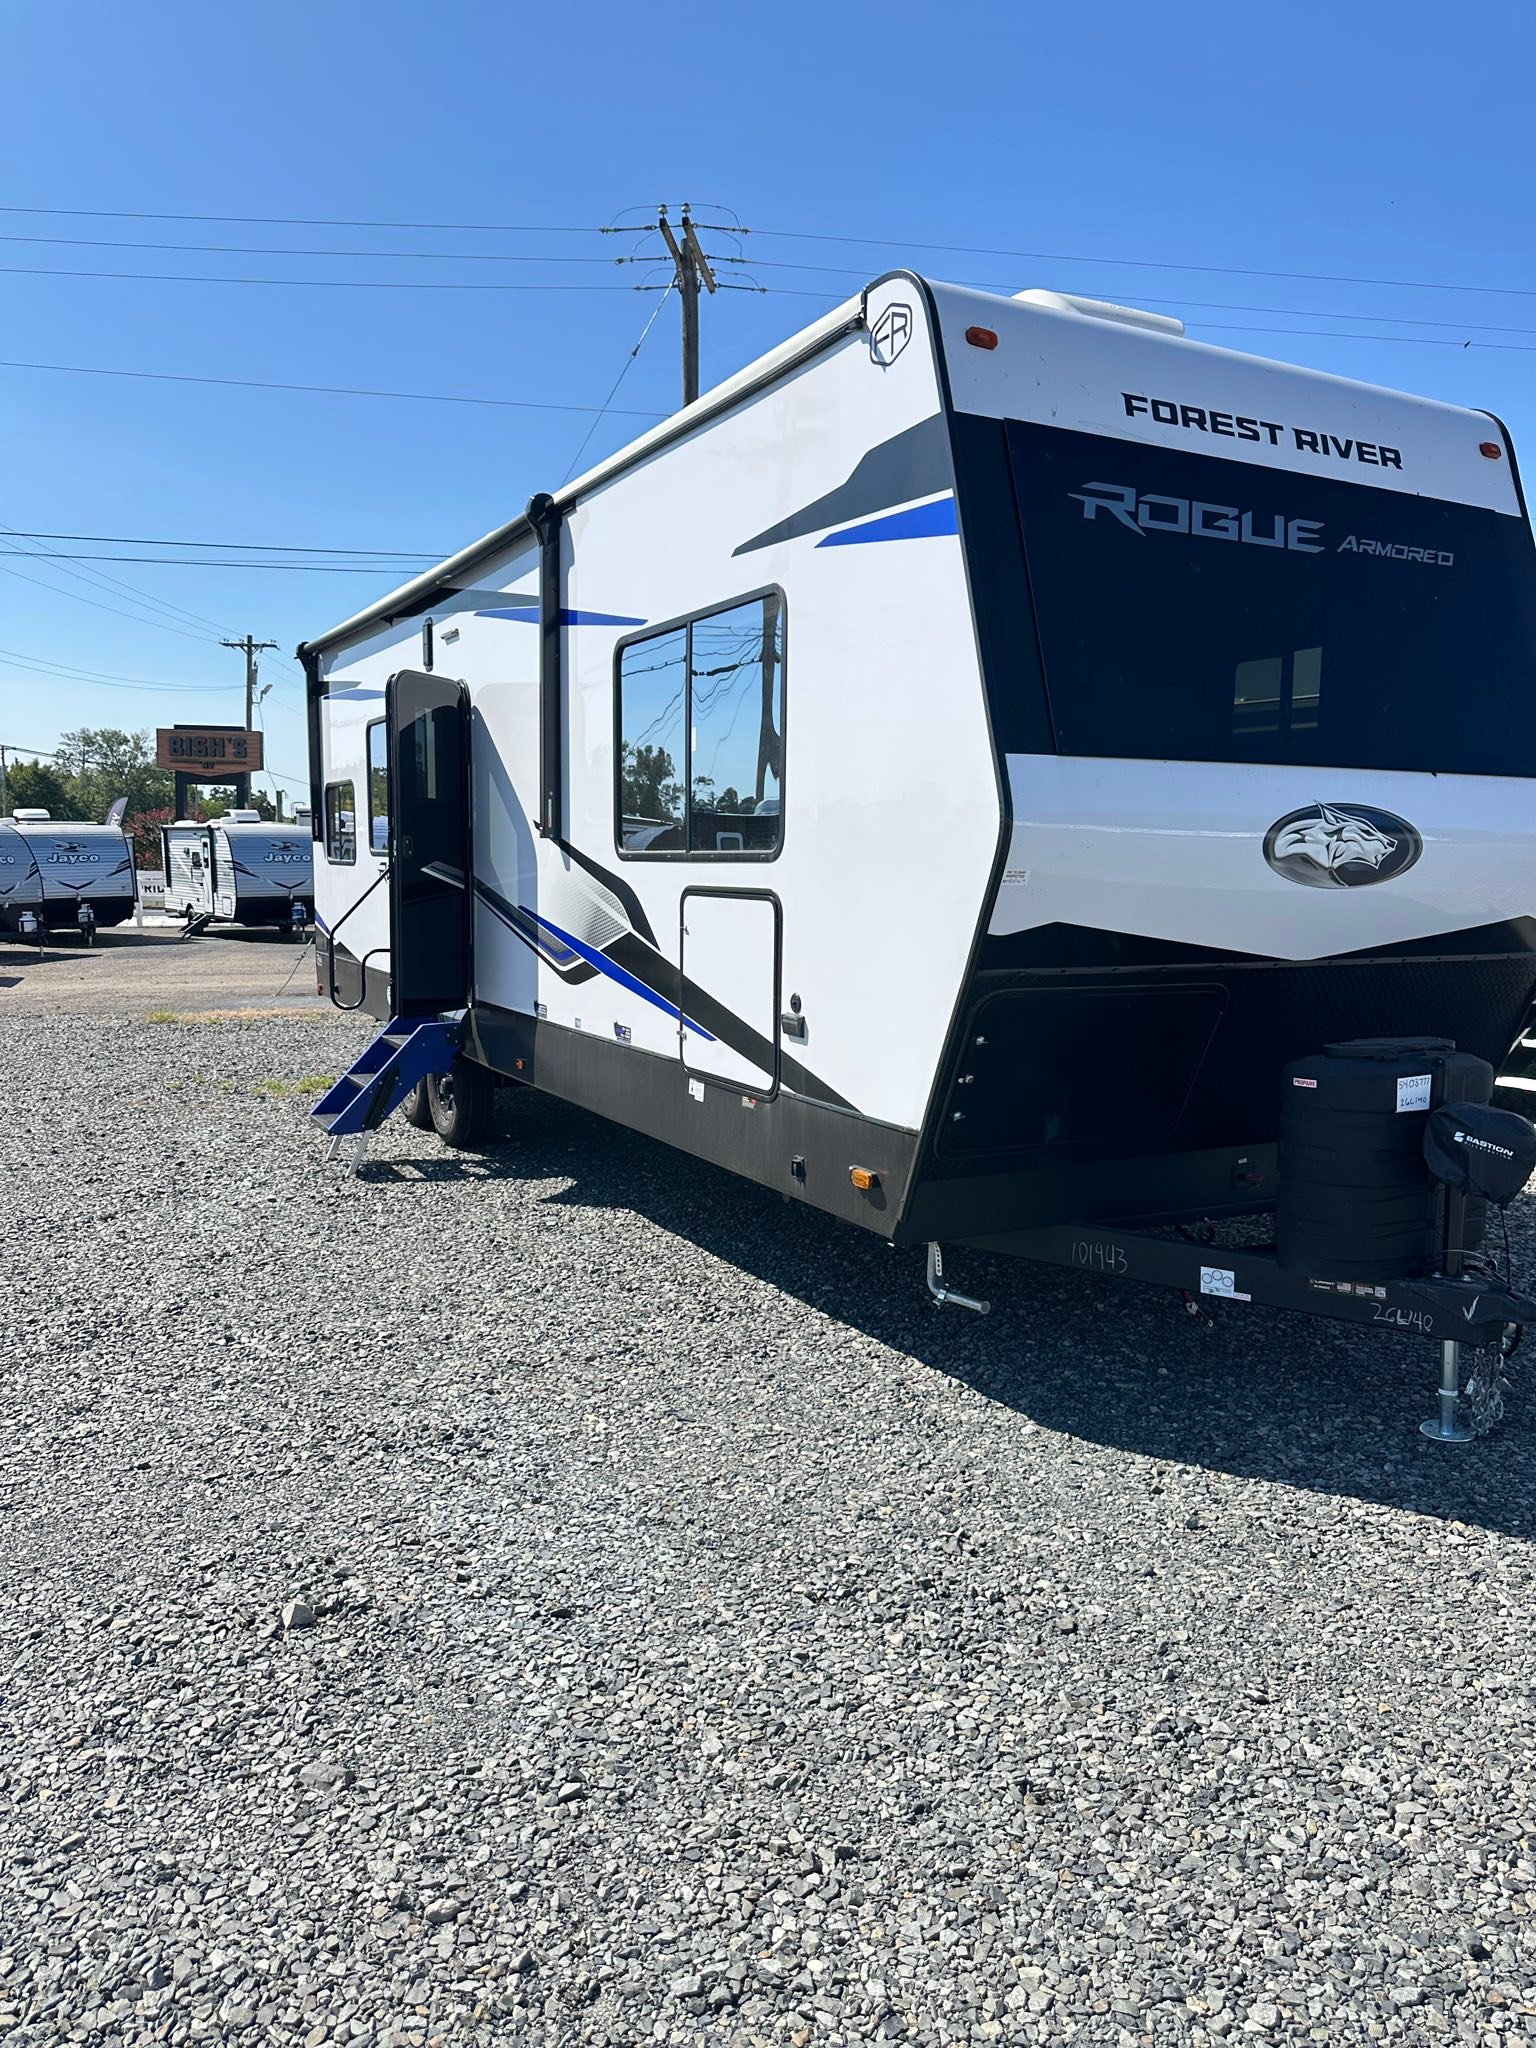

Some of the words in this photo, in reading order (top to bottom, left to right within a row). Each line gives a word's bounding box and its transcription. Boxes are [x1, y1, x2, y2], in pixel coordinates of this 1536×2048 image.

[1121, 392, 1284, 445] FOREST
[1291, 427, 1404, 471] RIVER
[1067, 481, 1326, 554] ROGUE
[1337, 535, 1454, 567] ARMORED
[168, 735, 248, 758] BISH'S
[47, 853, 100, 865] Jayco
[264, 852, 312, 864] Jayco
[1466, 1135, 1514, 1157] BASTION
[1072, 1241, 1128, 1273] 101943
